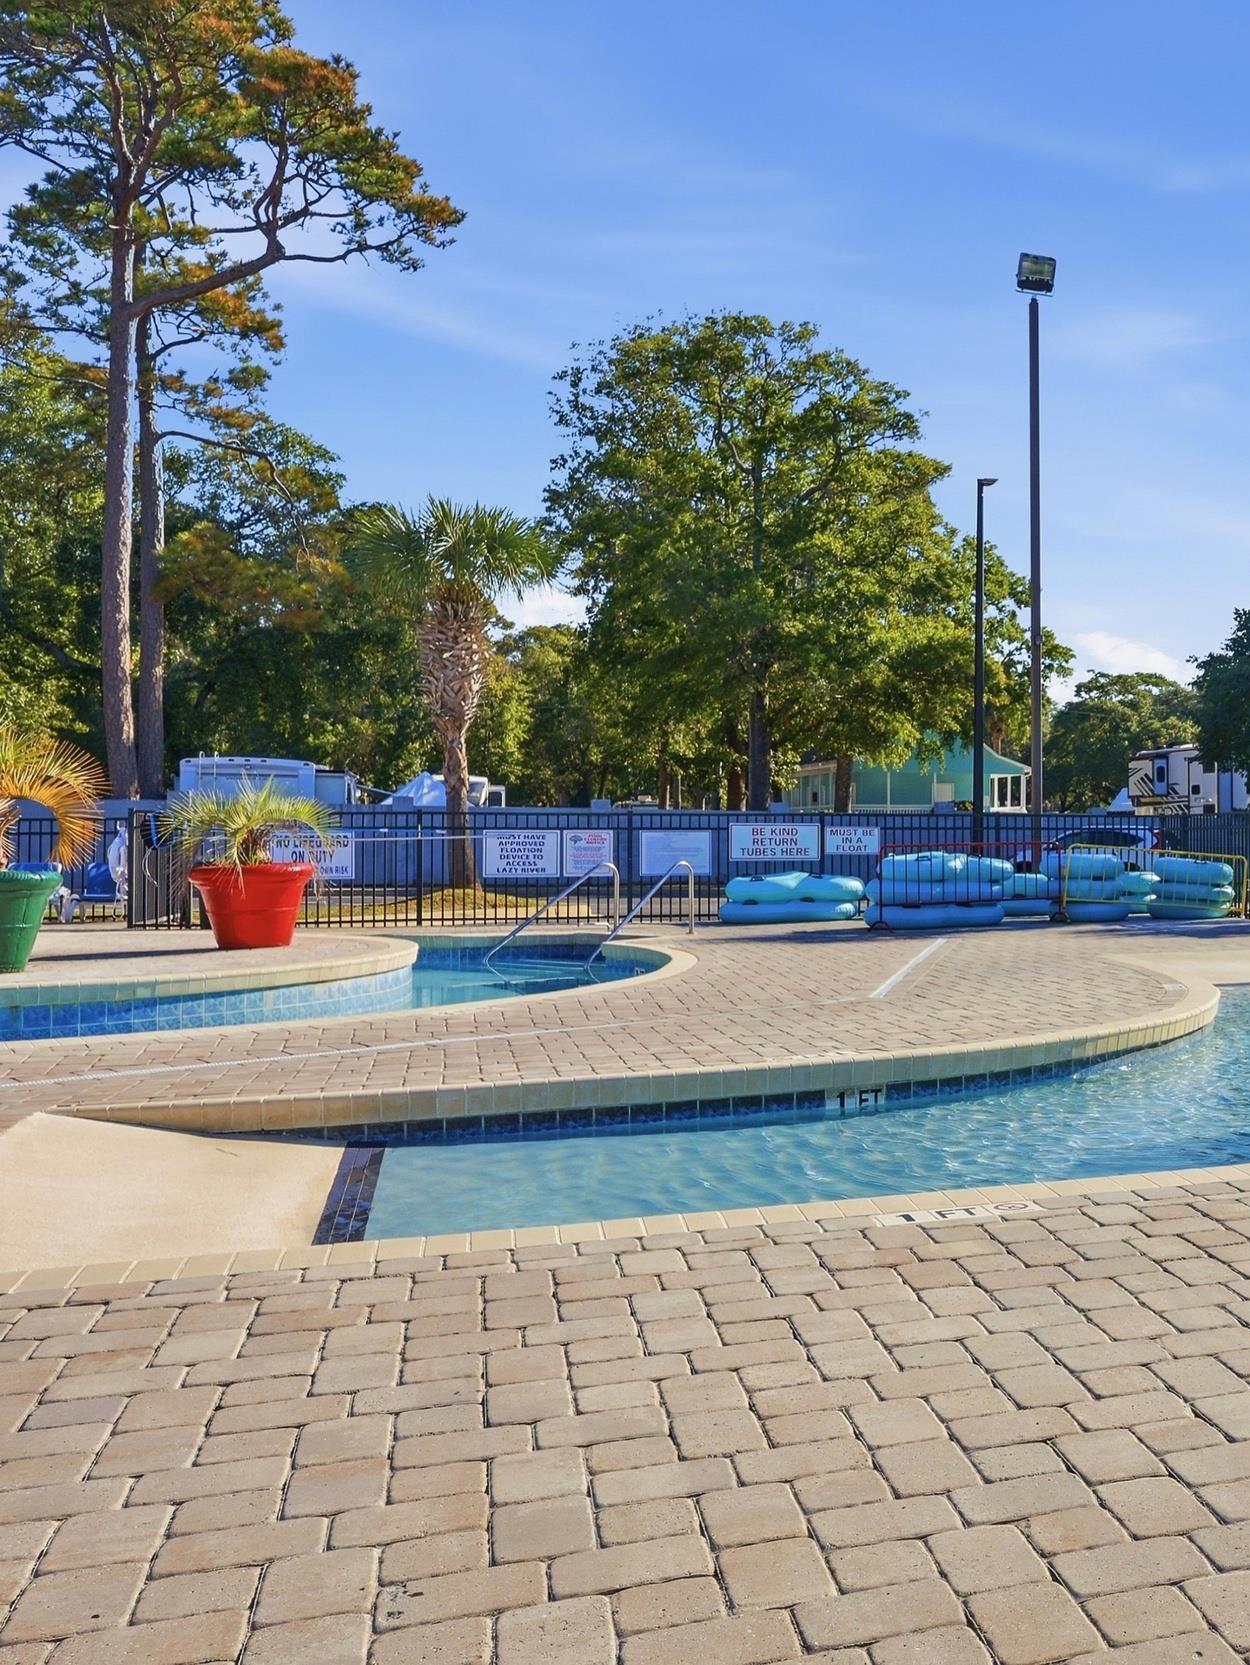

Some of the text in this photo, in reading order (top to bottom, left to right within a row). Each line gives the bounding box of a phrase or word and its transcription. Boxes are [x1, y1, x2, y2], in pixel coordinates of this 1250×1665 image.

[752, 827, 798, 836] BE KIND
[276, 835, 290, 848] NO
[752, 838, 798, 846] RETURN
[291, 850, 305, 863] ON
[740, 848, 810, 857] TUBES HERE
[335, 865, 349, 875] RISK
[836, 1089, 882, 1109] 1 FT
[896, 1207, 976, 1222] 1 FT
